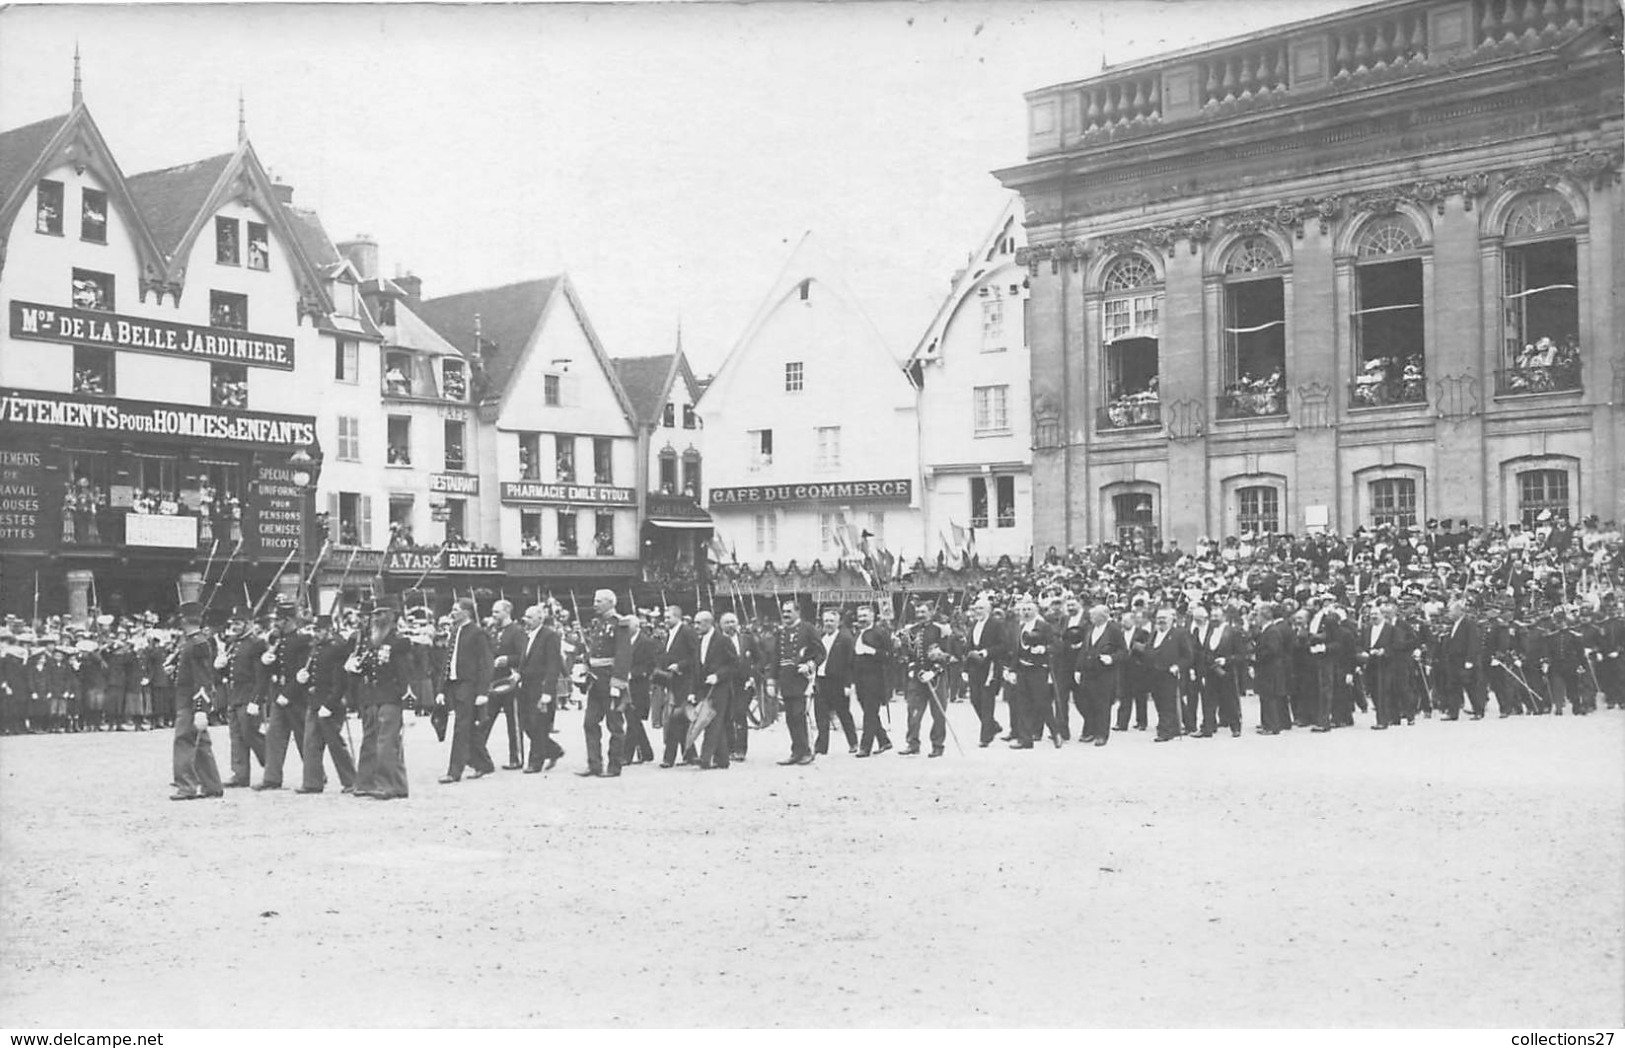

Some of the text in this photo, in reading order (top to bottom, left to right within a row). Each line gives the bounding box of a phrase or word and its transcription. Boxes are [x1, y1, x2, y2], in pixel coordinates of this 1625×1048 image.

[60, 316, 85, 338] DE
[88, 320, 113, 342] LA
[118, 321, 177, 350] BELLE
[119, 415, 153, 432] POUR
[153, 409, 228, 439] HOMMES
[228, 425, 237, 440] &
[236, 416, 315, 445] ENFANTS
[430, 475, 478, 494] RESTAURANT
[506, 484, 566, 498] PHARMACIE
[568, 486, 597, 500] EMILE
[713, 481, 908, 503] CAFE DU COMMERCE
[0, 499, 39, 511] OUSES
[258, 510, 301, 520] PENSIONS
[258, 523, 301, 535] CHEMISES
[261, 537, 299, 549] TRICOTS
[449, 554, 498, 568] BUVETTE
